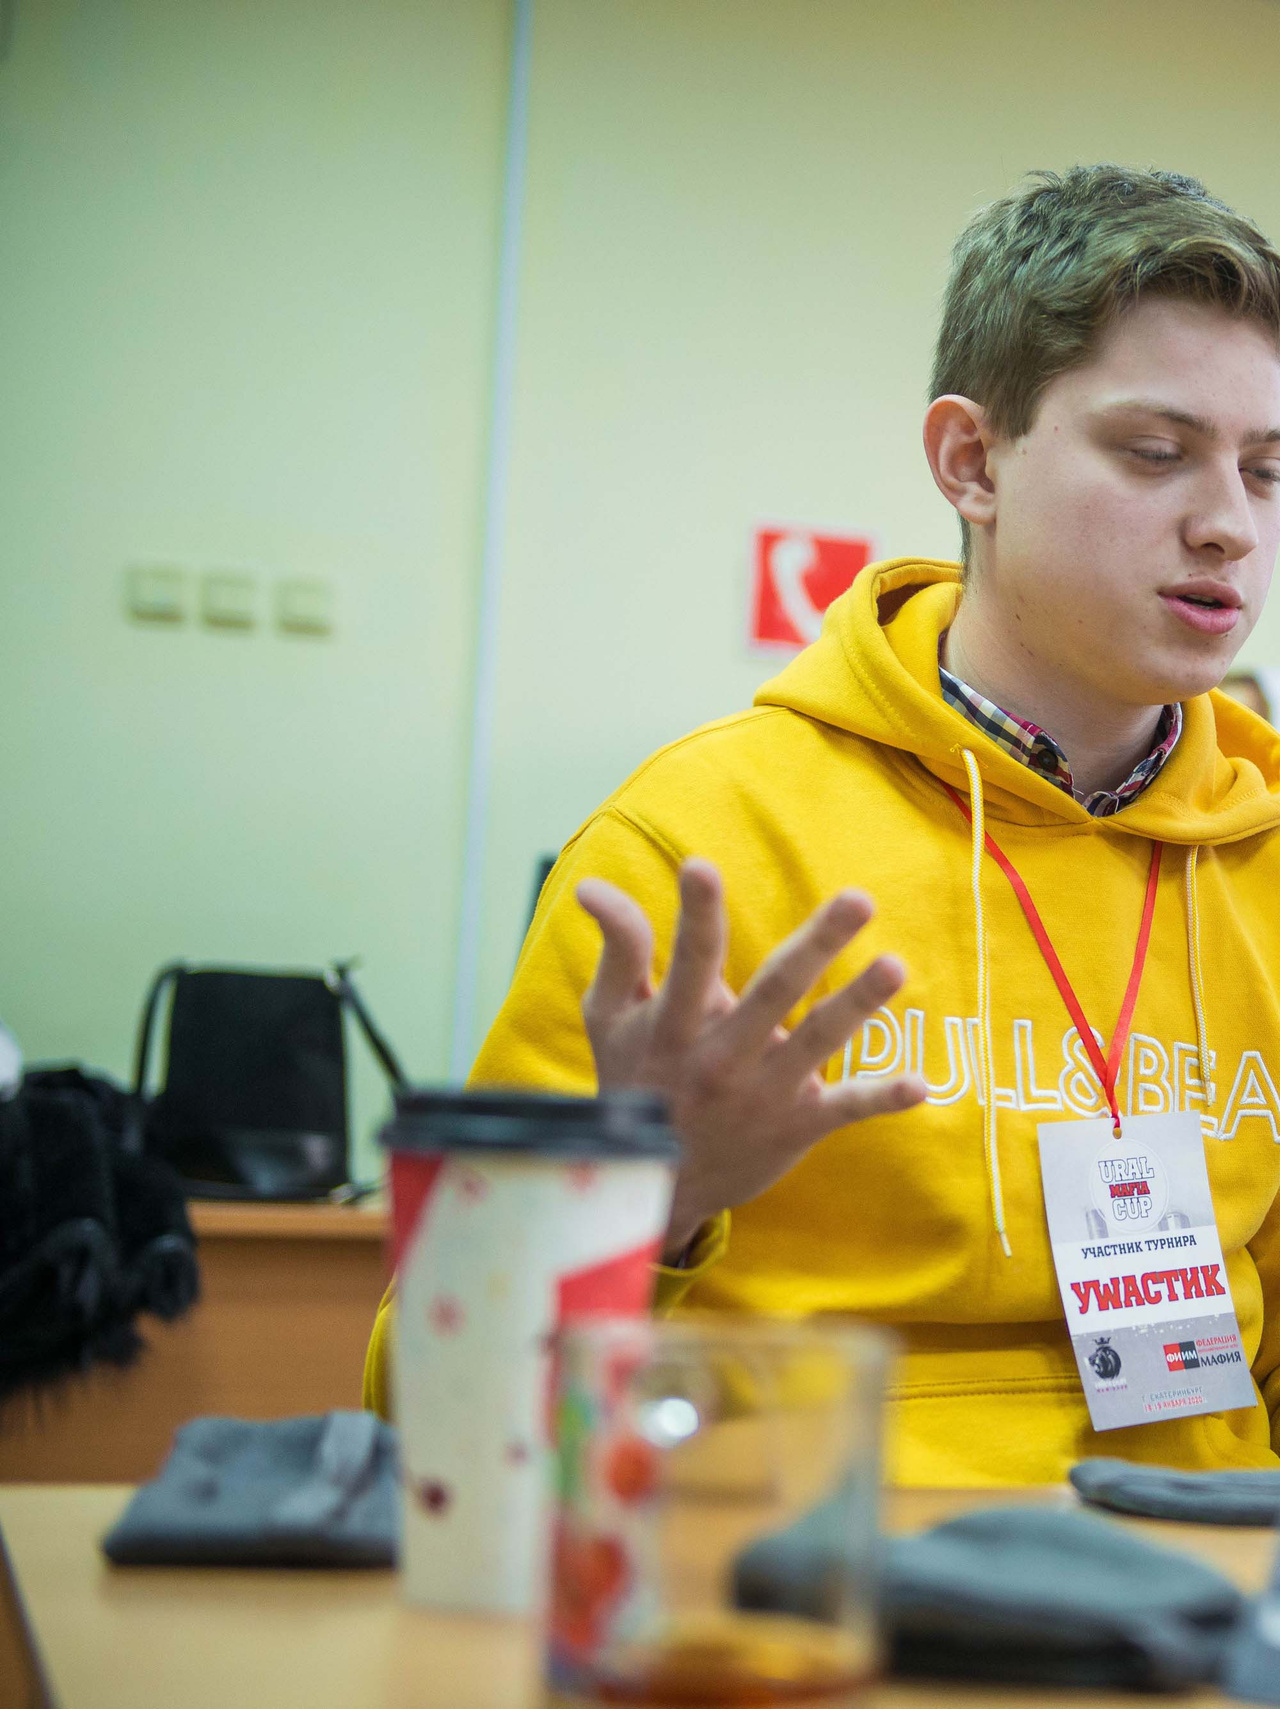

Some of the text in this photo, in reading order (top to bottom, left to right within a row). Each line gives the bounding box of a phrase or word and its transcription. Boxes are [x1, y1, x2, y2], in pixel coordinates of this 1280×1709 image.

[1097, 1156, 1155, 1183] URAL
[1108, 1180, 1151, 1199] MAFIA
[1111, 1195, 1153, 1222] CUP
[1081, 1234, 1198, 1260] УЧАСТНИК ТУРНИРА
[1200, 1350, 1242, 1367] МАФИЯ
